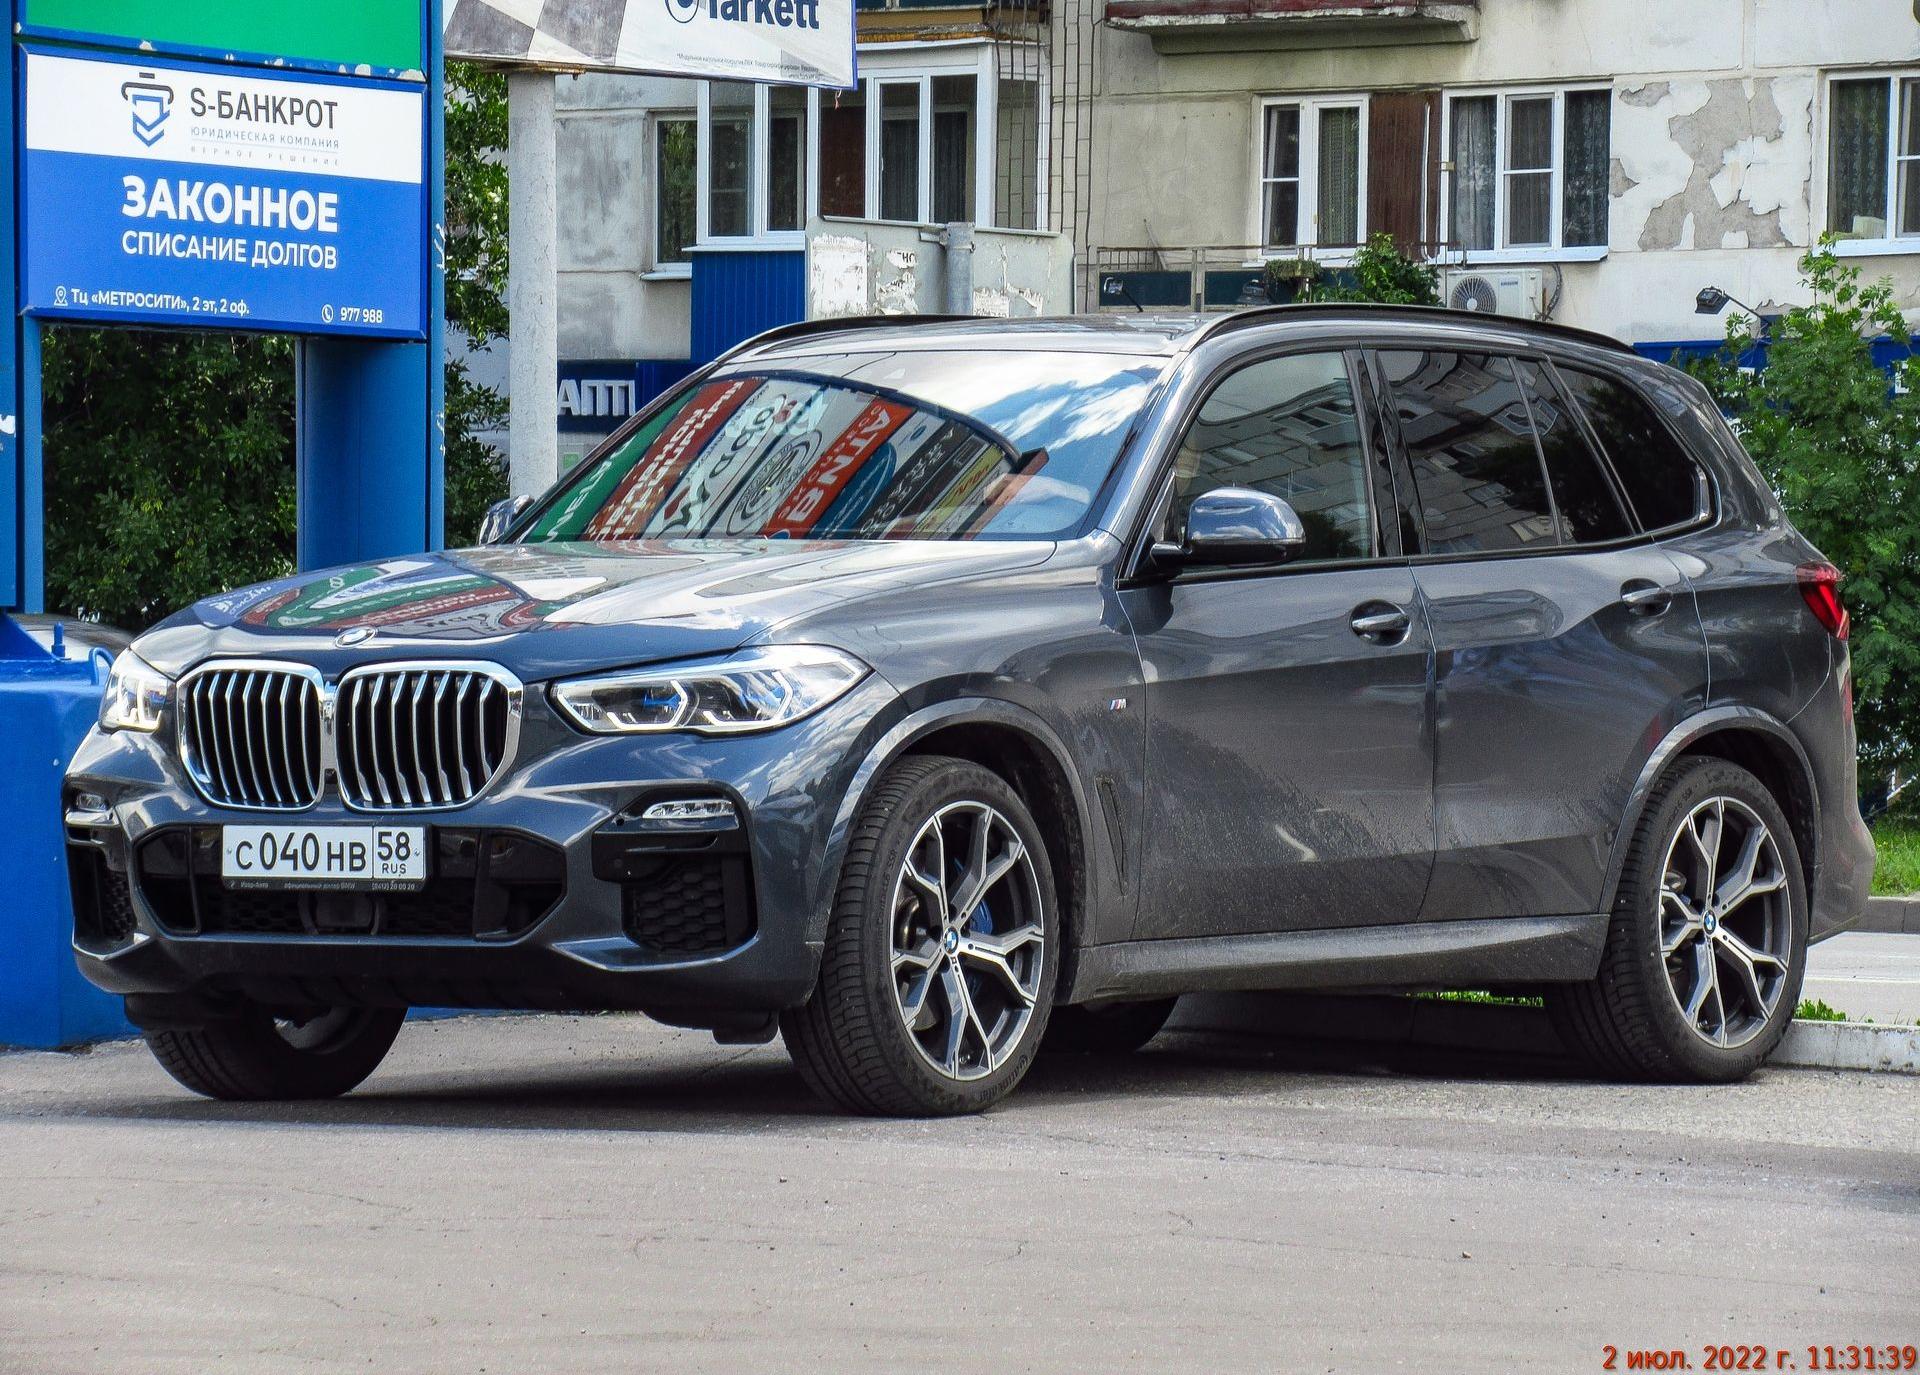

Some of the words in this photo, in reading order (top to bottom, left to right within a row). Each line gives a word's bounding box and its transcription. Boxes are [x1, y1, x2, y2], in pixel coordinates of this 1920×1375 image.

[190, 88, 338, 129] S-БАНКРОТ
[191, 126, 275, 143] ЮРИДИЧЕСКАЯ
[280, 135, 339, 149] КОМПАНИЯ
[122, 175, 338, 233] ЗАКОННОЕ
[122, 230, 247, 264] СПИСАНИЕ
[252, 241, 337, 270] ДОЛГОВ
[192, 297, 200, 312] 2
[220, 299, 228, 313] 2
[229, 301, 250, 316] оф.
[340, 307, 361, 322] 977
[362, 308, 383, 323] 988
[377, 831, 411, 861] 58
[381, 863, 407, 875] RUS
